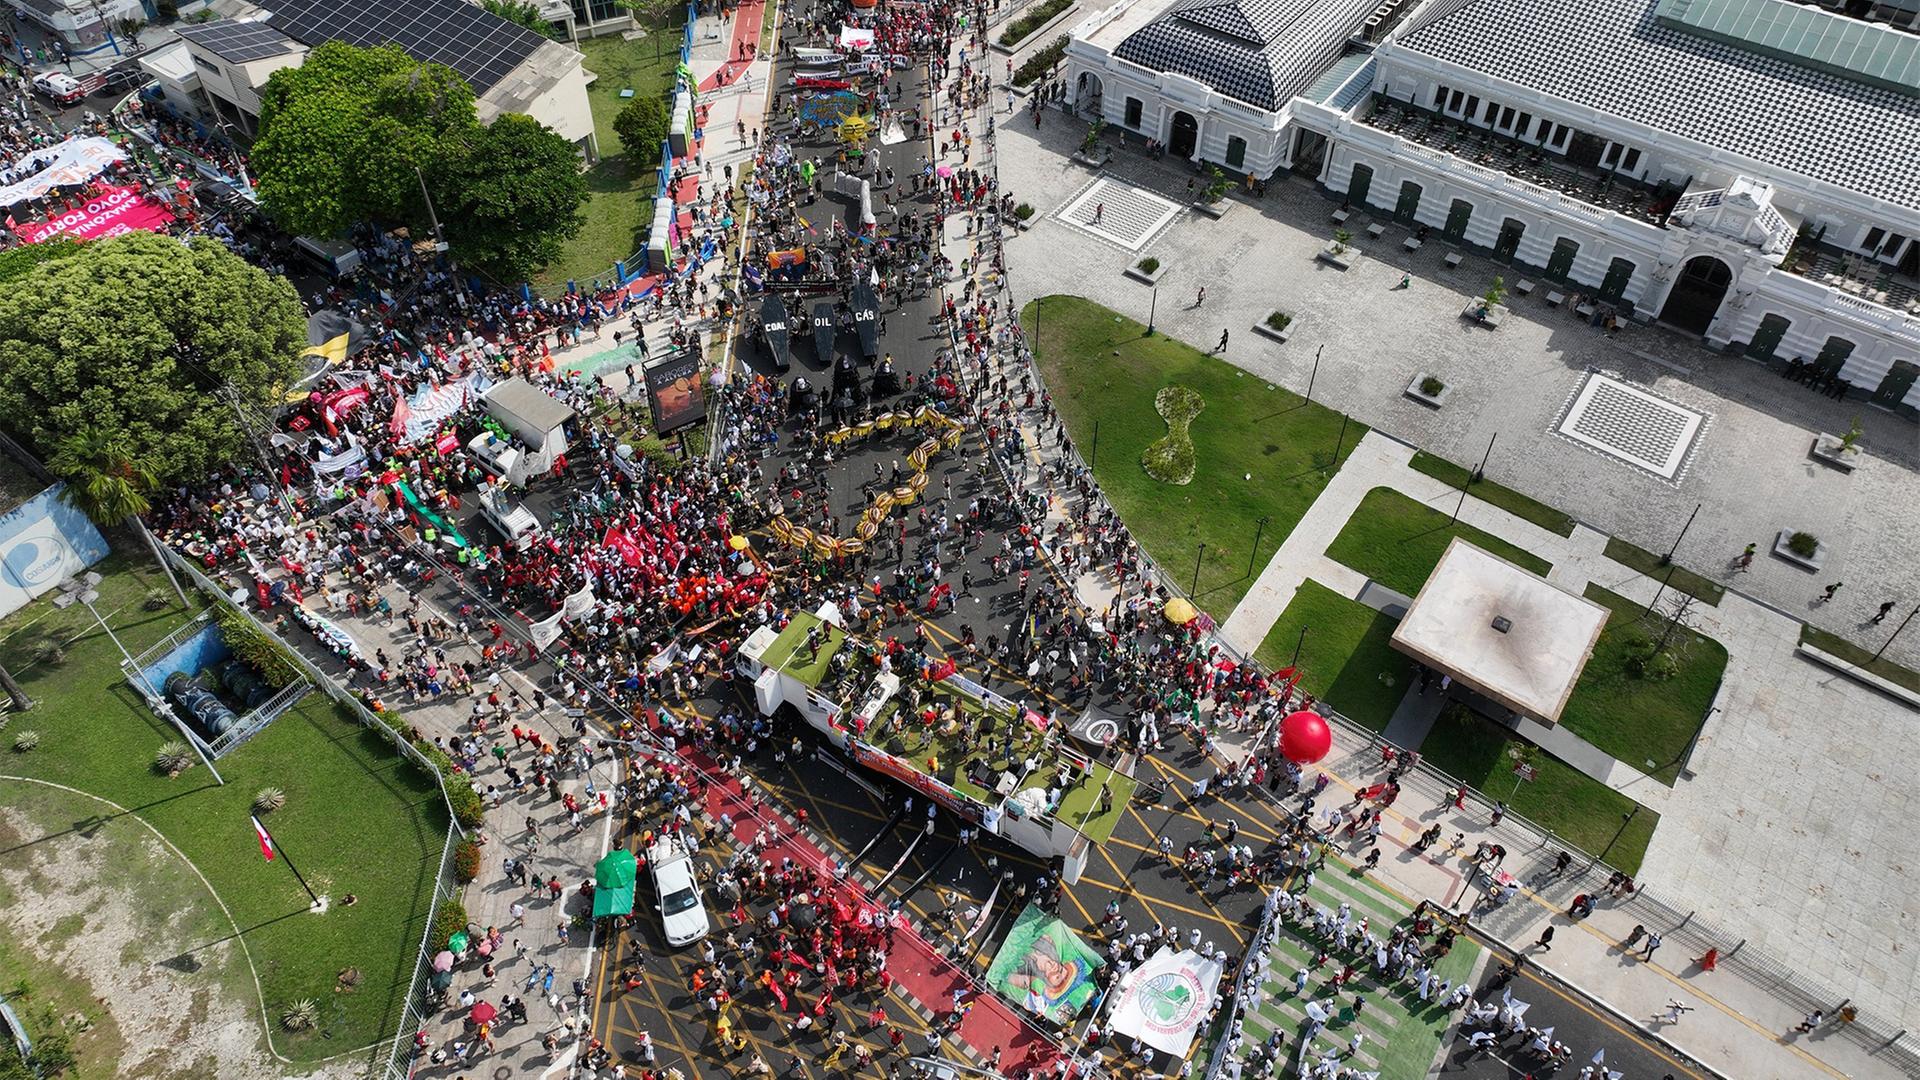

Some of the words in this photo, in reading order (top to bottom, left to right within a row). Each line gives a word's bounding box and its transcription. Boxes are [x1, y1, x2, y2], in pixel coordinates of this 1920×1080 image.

[87, 189, 131, 214] POVO
[69, 195, 137, 236] AMAZÔNIA
[34, 210, 87, 243] FORTE!
[814, 317, 832, 327] OIL
[855, 309, 874, 322] GÁS
[765, 322, 786, 332] COAL
[653, 362, 695, 381] SABORES
